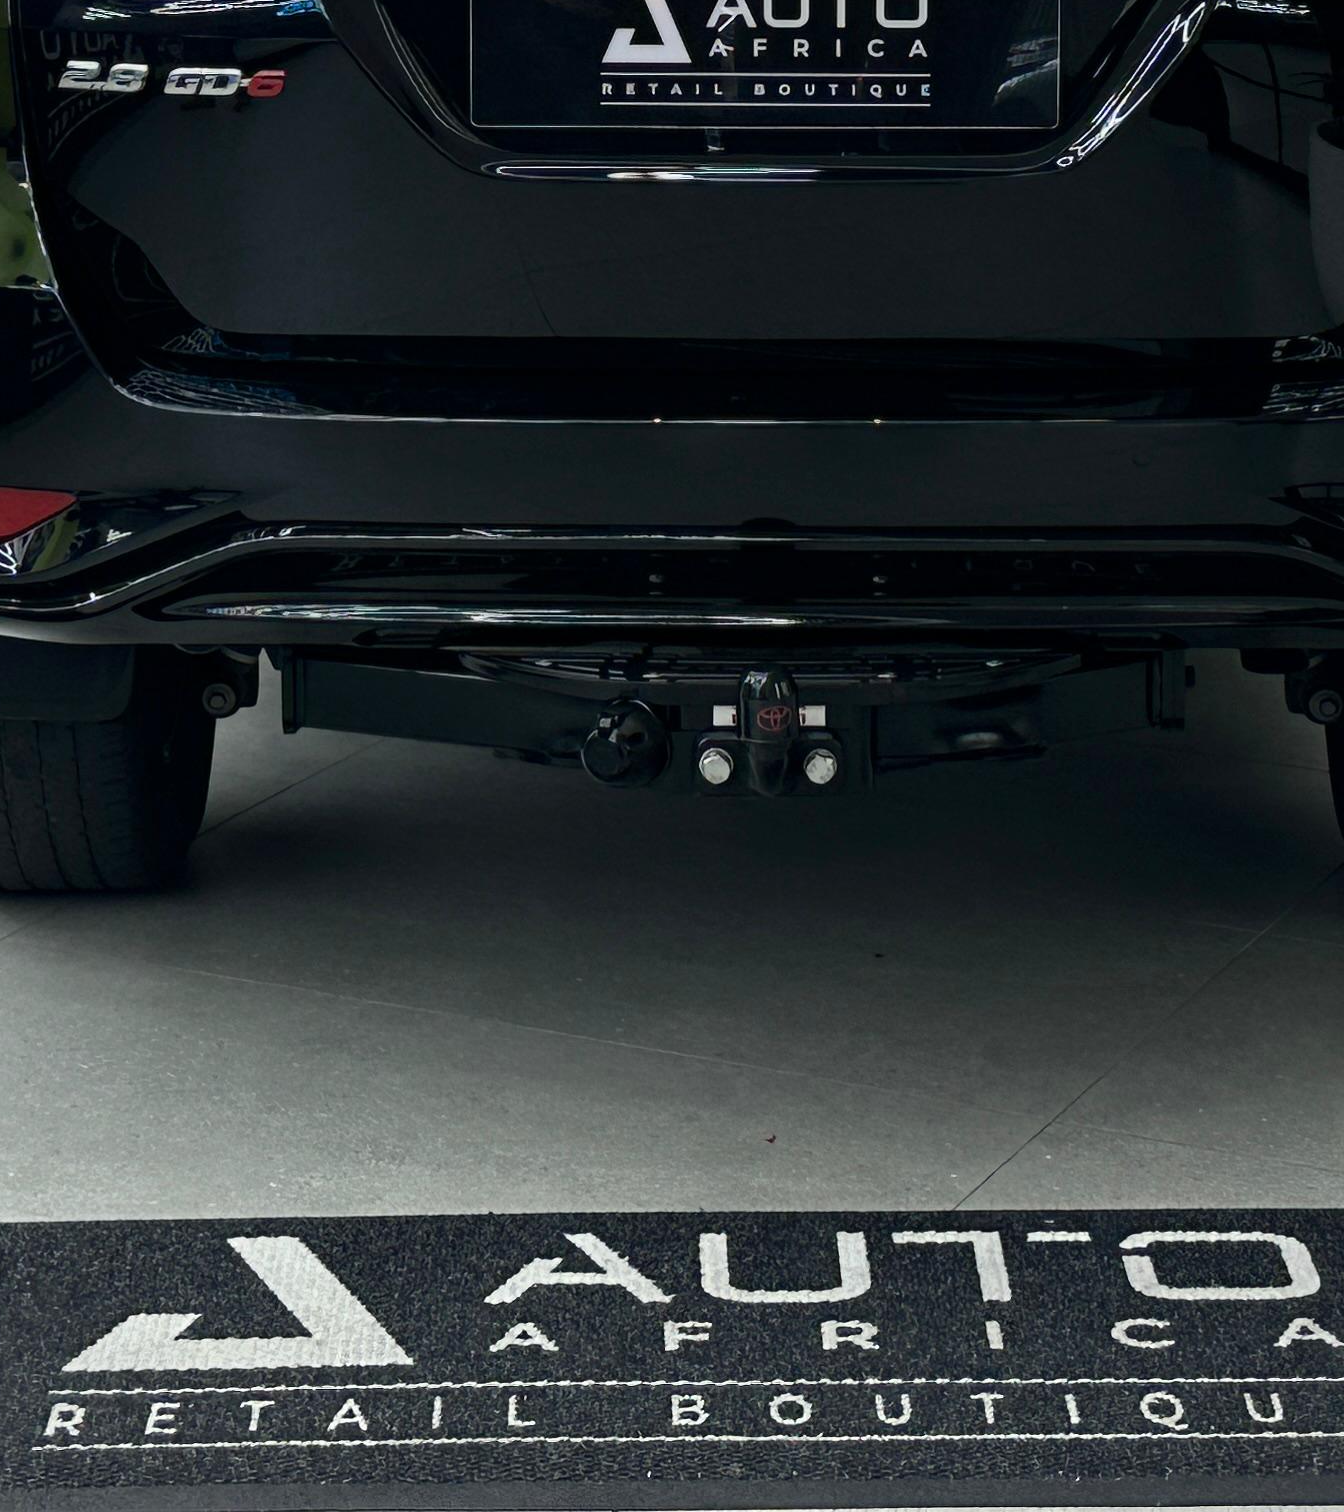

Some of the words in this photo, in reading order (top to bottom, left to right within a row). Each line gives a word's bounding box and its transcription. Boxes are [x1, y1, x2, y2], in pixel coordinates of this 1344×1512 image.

[709, 38, 928, 59] AFRICA
[163, 66, 287, 98] GD-6
[602, 82, 723, 97] RETAIL
[754, 82, 931, 99] BOUTIQUE
[483, 1228, 1325, 1304] AUTO
[45, 1392, 539, 1437] RETAIL
